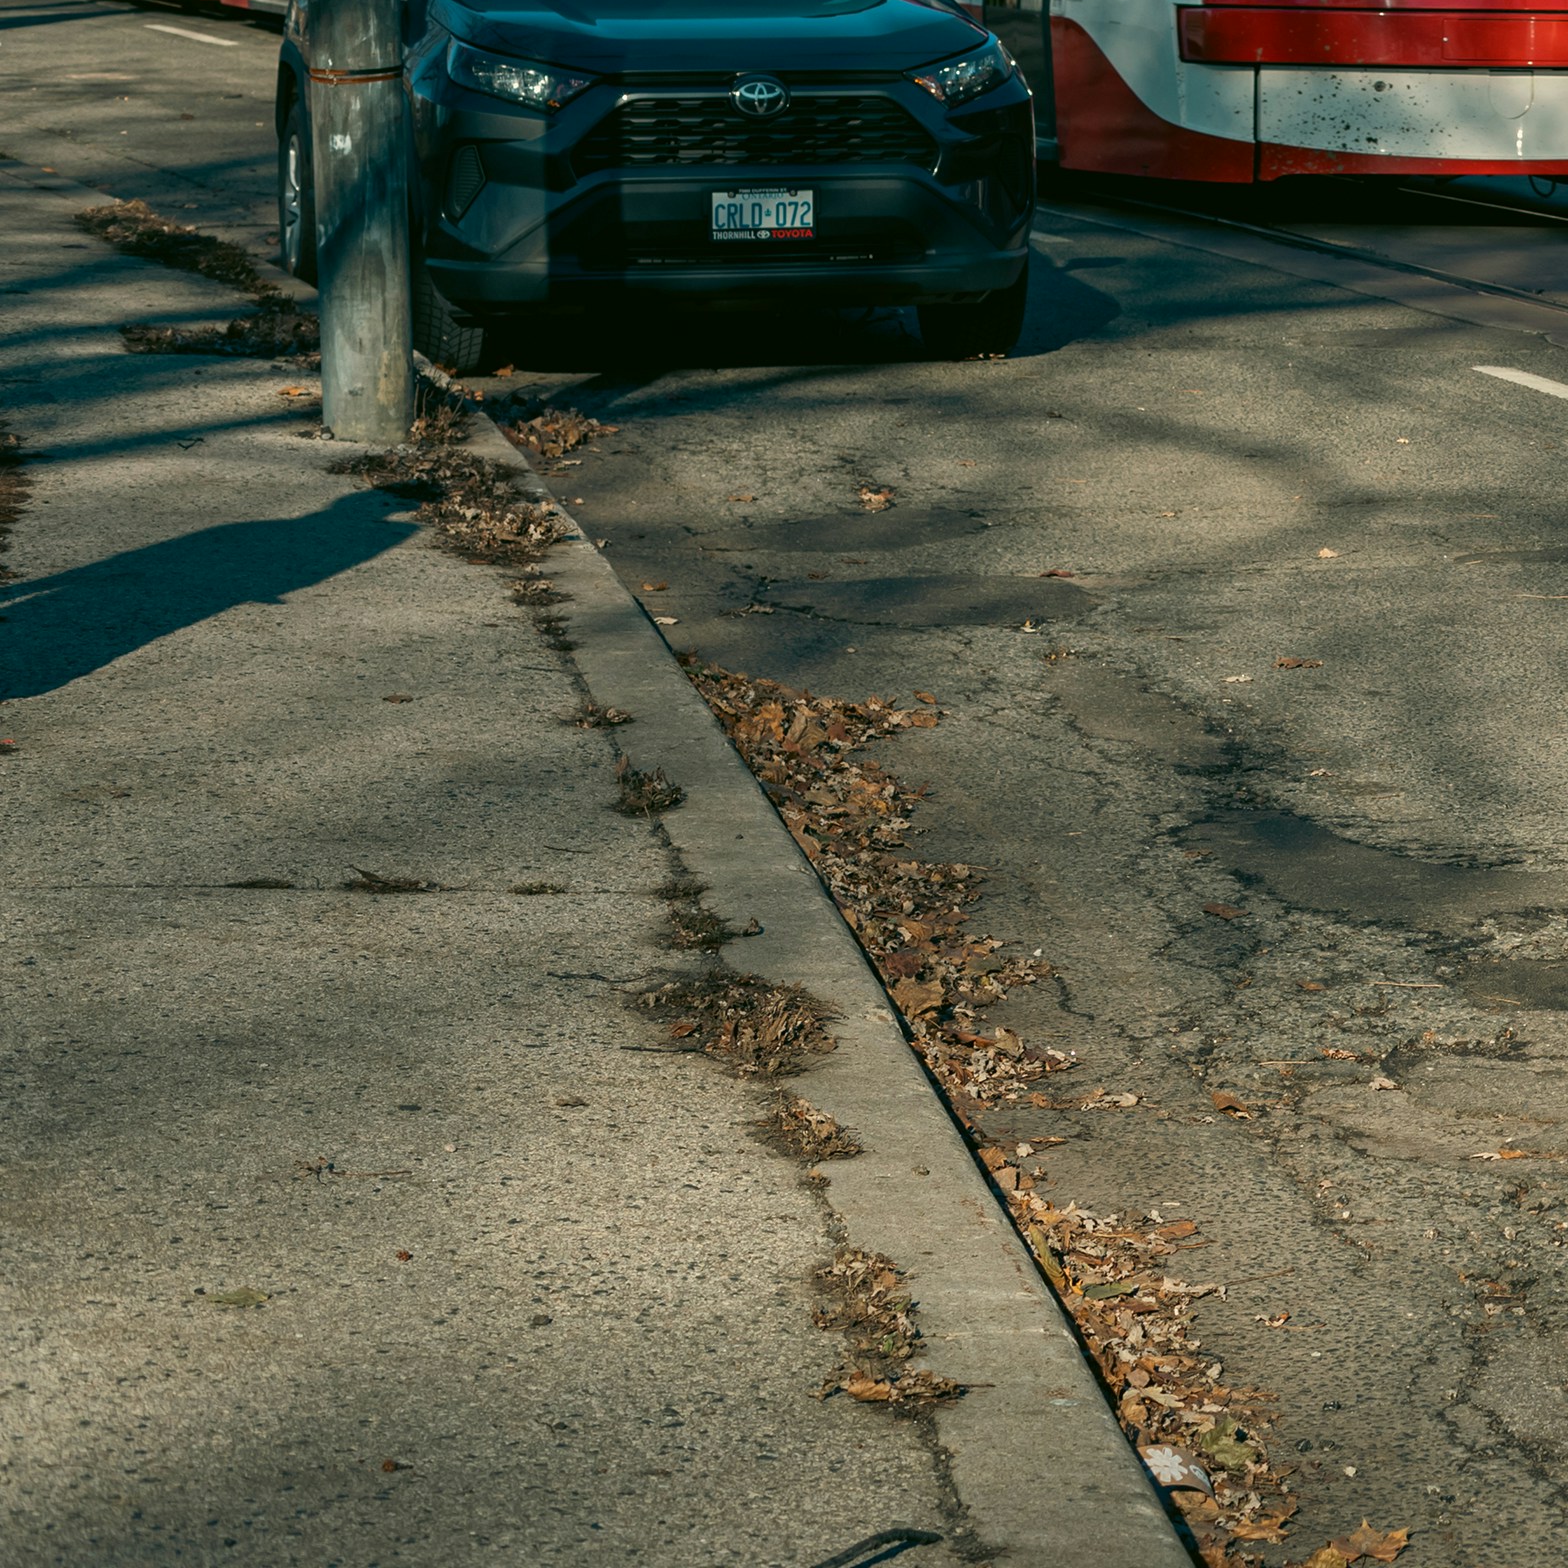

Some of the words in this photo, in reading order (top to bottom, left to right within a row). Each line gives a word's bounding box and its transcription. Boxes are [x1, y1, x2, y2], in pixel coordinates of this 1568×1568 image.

[715, 203, 762, 228] CRLD
[775, 200, 812, 227] 072
[713, 231, 756, 240] THORNHILL
[771, 229, 813, 239] TOYOTA
